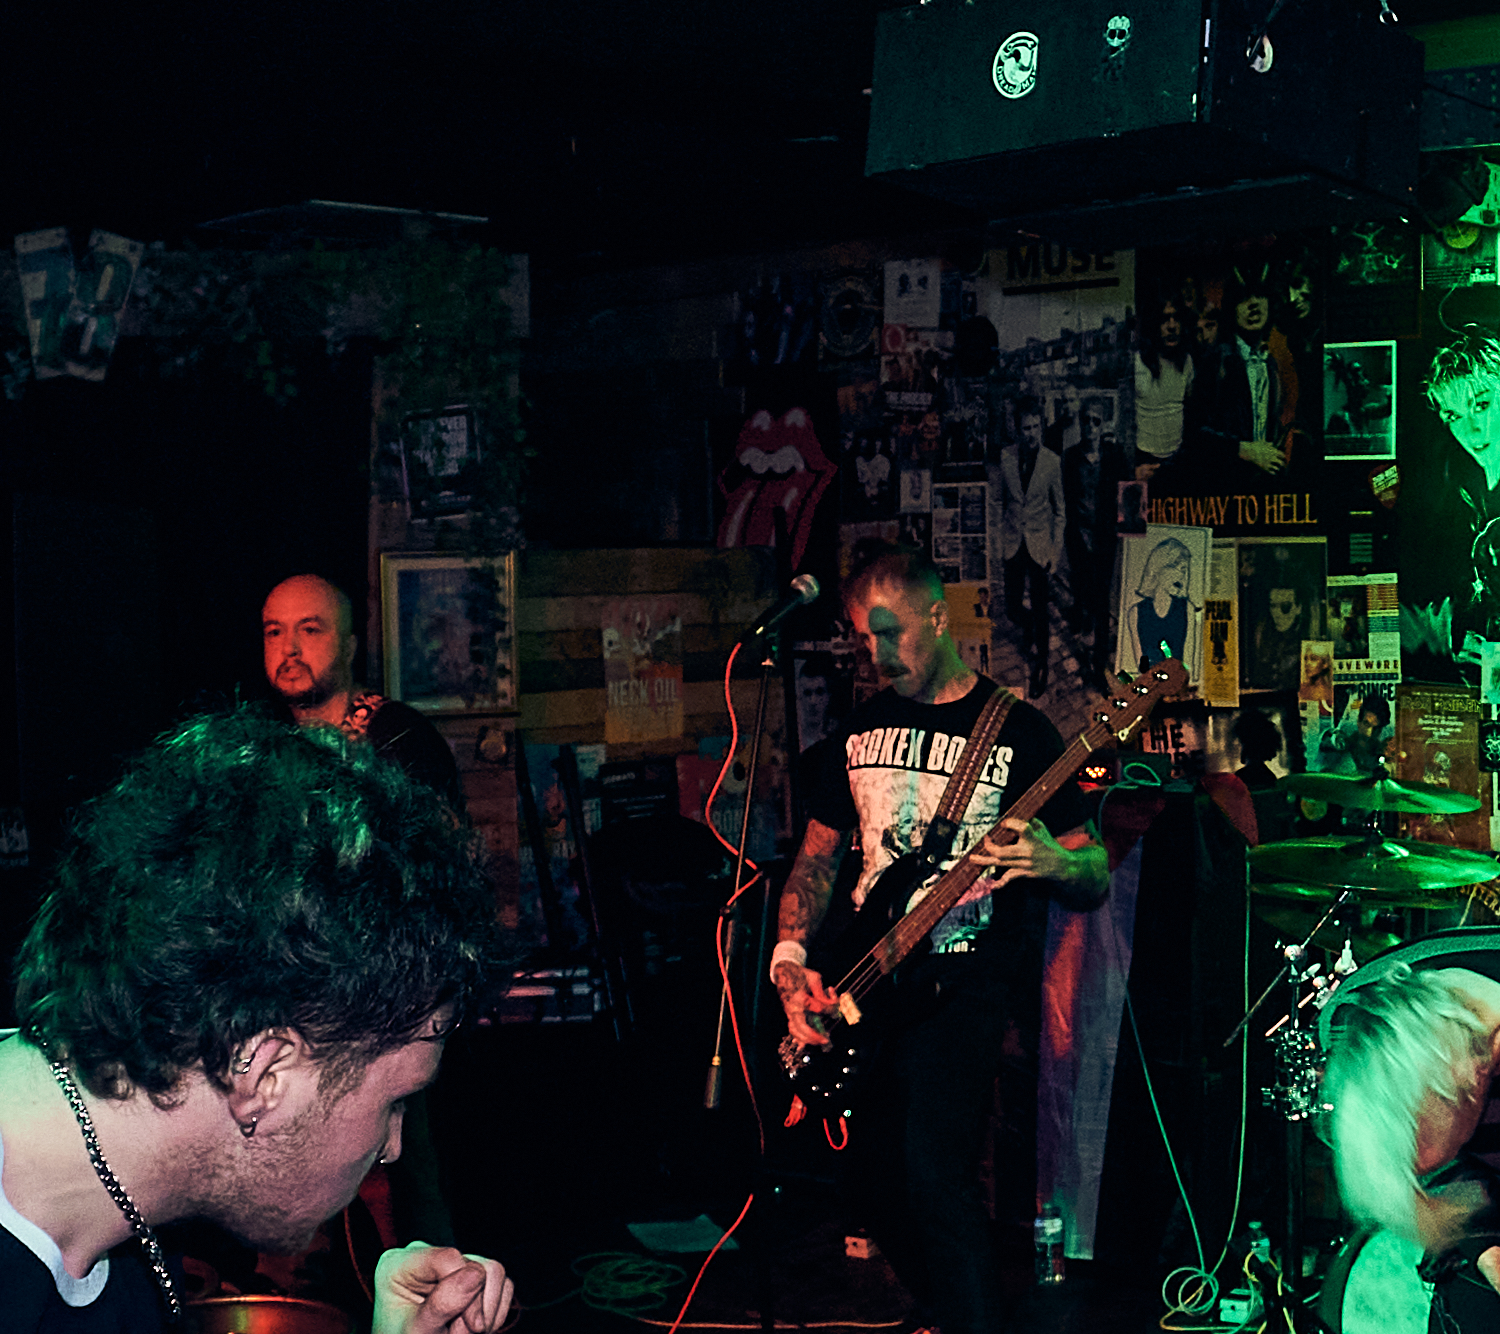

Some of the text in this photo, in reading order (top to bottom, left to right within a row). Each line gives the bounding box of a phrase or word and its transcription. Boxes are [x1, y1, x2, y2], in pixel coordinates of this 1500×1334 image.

[1005, 243, 1116, 280] MUSE
[1147, 492, 1318, 526] HIGHWAY TO HELL
[607, 676, 680, 706] NECK OIL
[927, 731, 1014, 788] BOES
